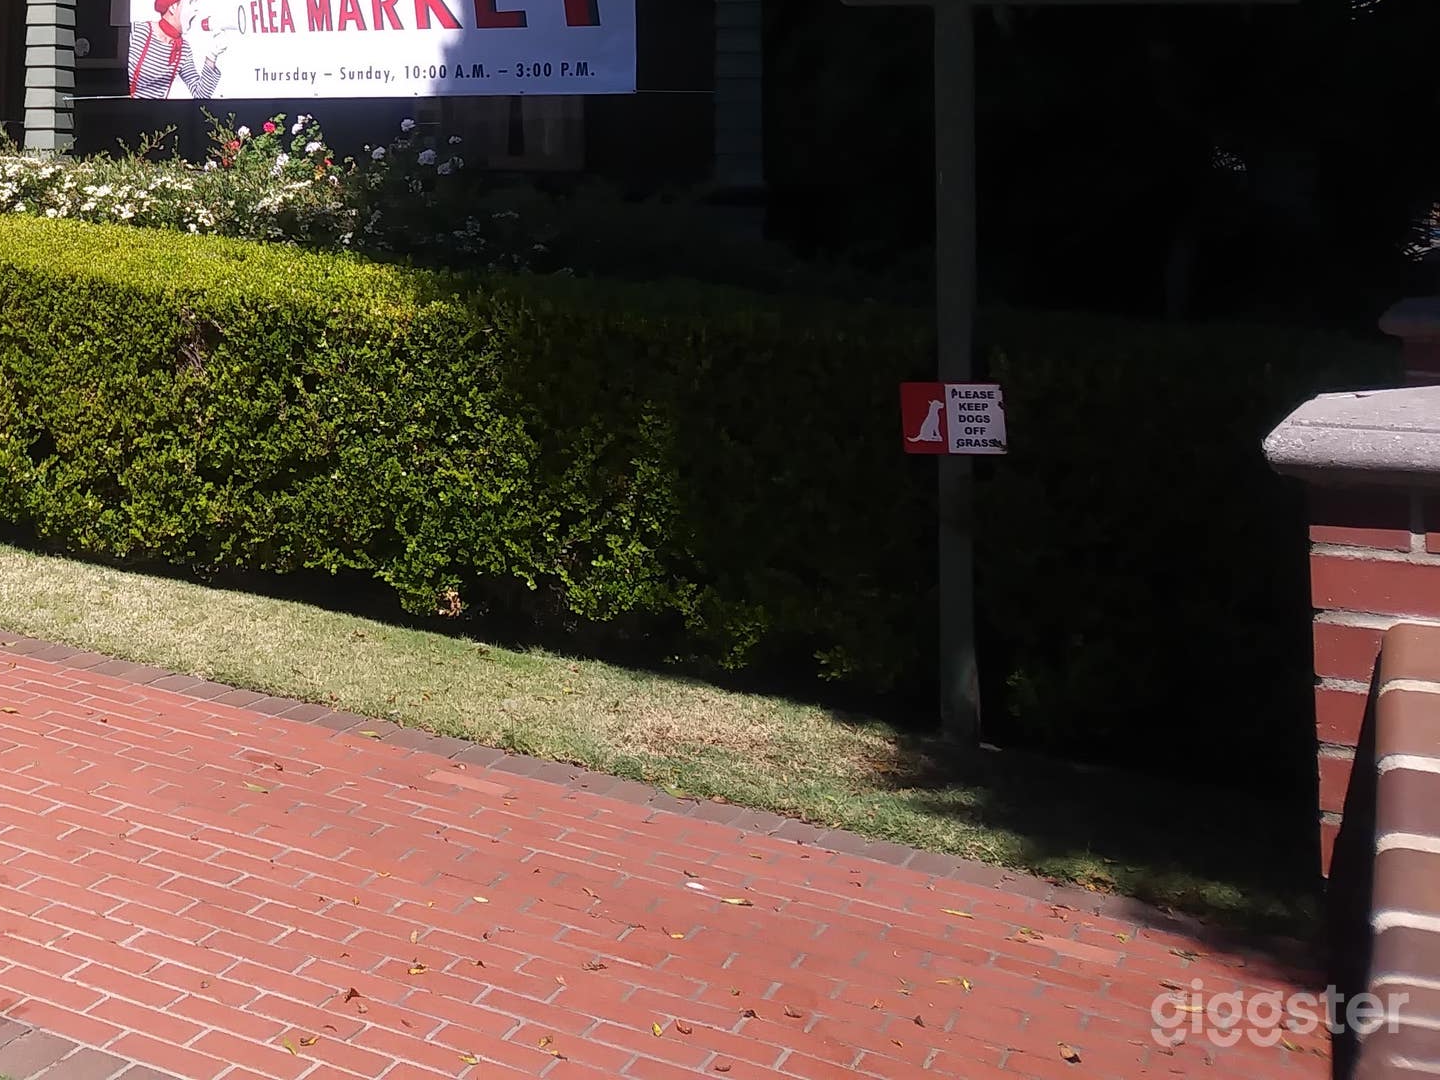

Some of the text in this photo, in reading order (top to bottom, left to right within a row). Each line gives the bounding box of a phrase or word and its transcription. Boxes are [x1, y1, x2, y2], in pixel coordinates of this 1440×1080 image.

[254, 67, 317, 85] Thursday
[339, 66, 397, 84] Sunday,
[404, 65, 447, 79] 10:00
[454, 63, 490, 79] A.M.
[515, 62, 552, 78] 3:00
[560, 62, 596, 77] P.M.
[951, 388, 995, 400] PLEASE
[958, 402, 989, 411] KEEP
[958, 415, 991, 423] DOGS
[964, 427, 987, 435] OFF
[956, 438, 995, 449] GRASS
